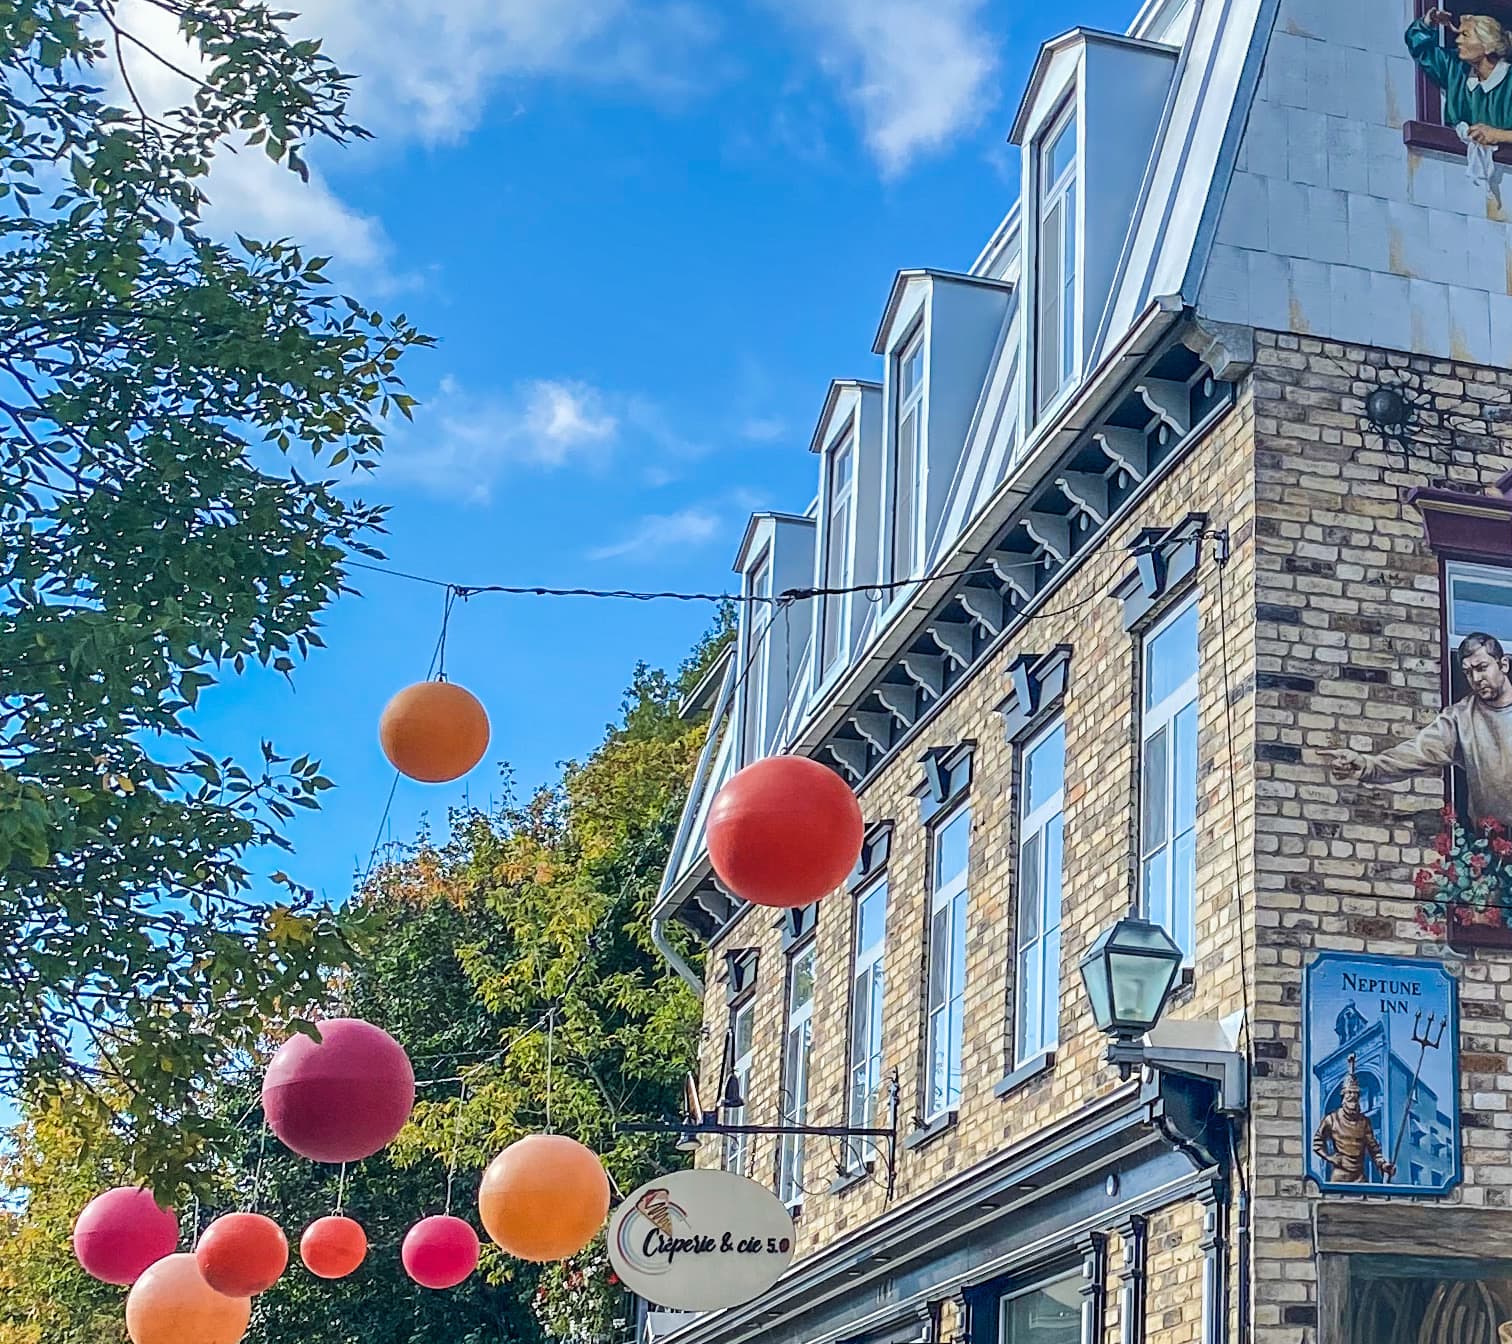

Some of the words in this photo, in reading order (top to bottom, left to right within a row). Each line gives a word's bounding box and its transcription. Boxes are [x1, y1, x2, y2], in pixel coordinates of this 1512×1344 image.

[1342, 972, 1422, 996] NEPTUNE
[1379, 999, 1409, 1014] INN
[720, 1231, 734, 1253] &
[737, 1236, 763, 1253] cie
